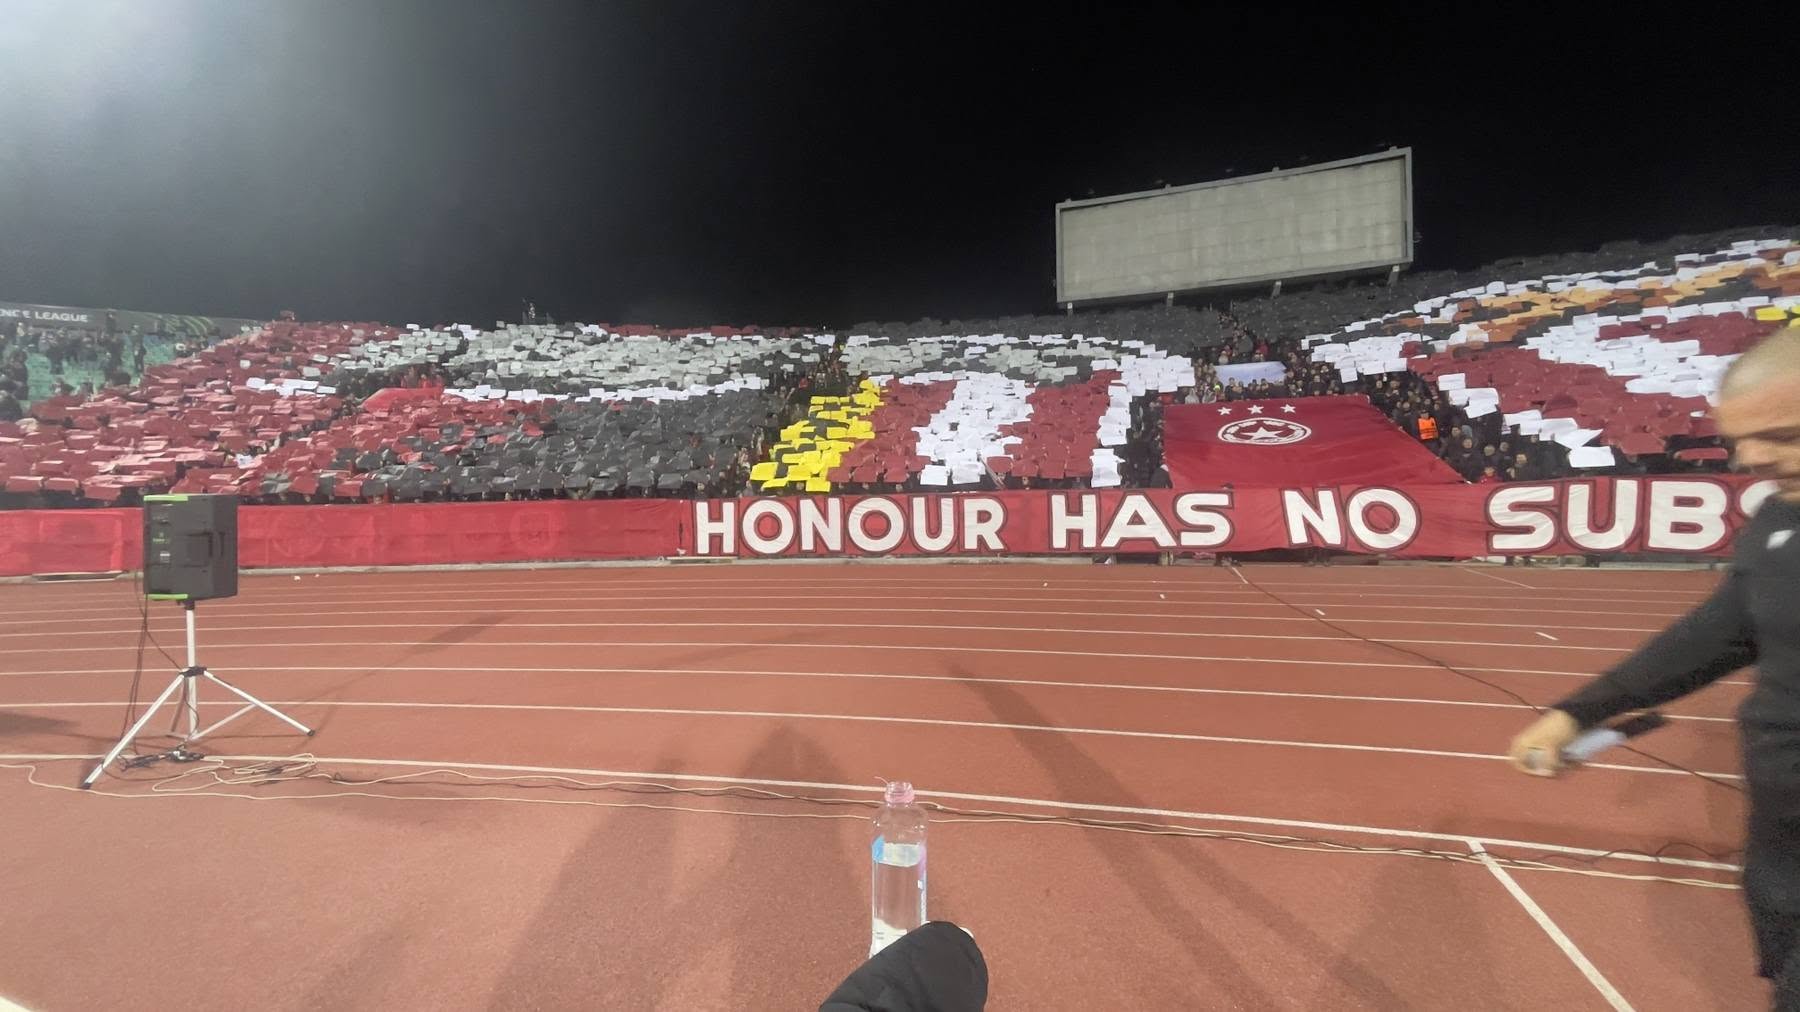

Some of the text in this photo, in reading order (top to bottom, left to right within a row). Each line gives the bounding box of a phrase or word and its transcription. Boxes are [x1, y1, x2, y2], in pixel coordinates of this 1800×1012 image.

[34, 311, 88, 323] LEAGUE
[694, 496, 1005, 555] HONOUR
[1050, 493, 1231, 549] HAS
[1284, 487, 1417, 549] NO
